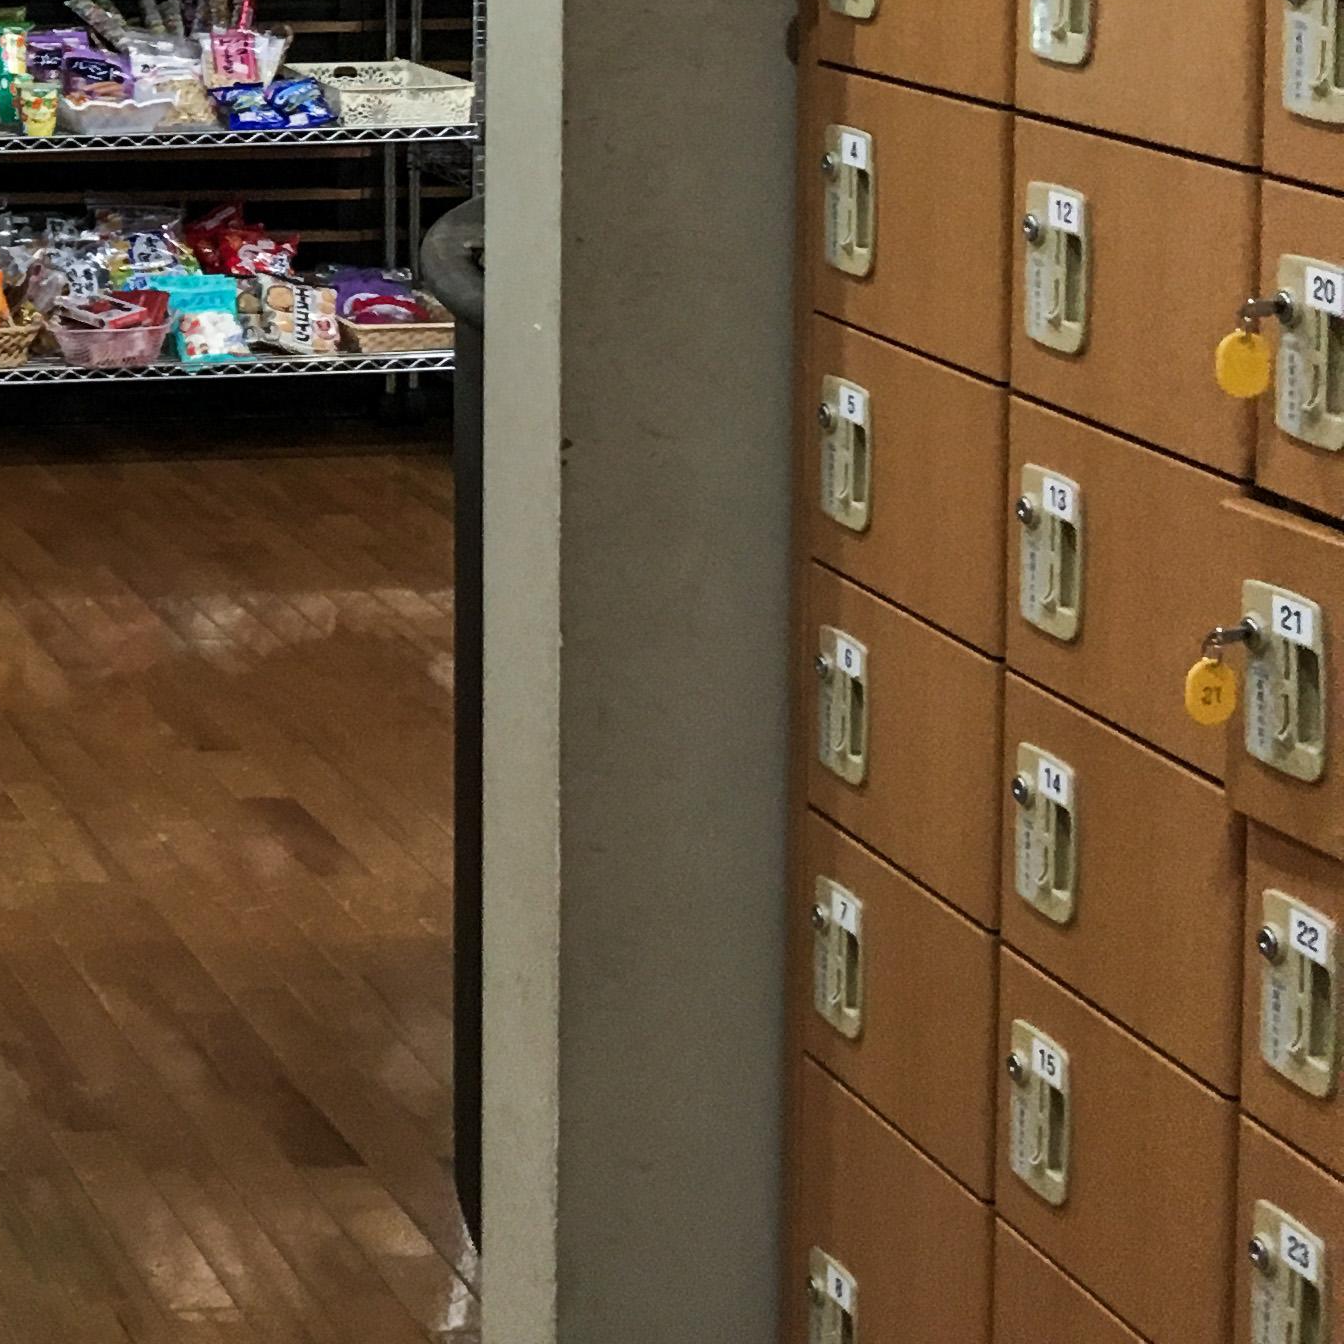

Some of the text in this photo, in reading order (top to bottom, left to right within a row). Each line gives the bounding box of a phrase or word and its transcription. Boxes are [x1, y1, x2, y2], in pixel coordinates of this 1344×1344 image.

[849, 141, 859, 160] 4
[1056, 200, 1073, 224] 12
[1313, 276, 1335, 303] 20
[847, 395, 856, 413] 5
[1049, 485, 1067, 510] 13
[1280, 606, 1303, 635] 21
[844, 649, 852, 667] 6
[1045, 768, 1061, 792] 14
[840, 902, 848, 920] 7
[1296, 920, 1319, 950] 22
[1039, 1049, 1057, 1075] 15
[1287, 1236, 1310, 1266] 23
[835, 1278, 843, 1297] 8
